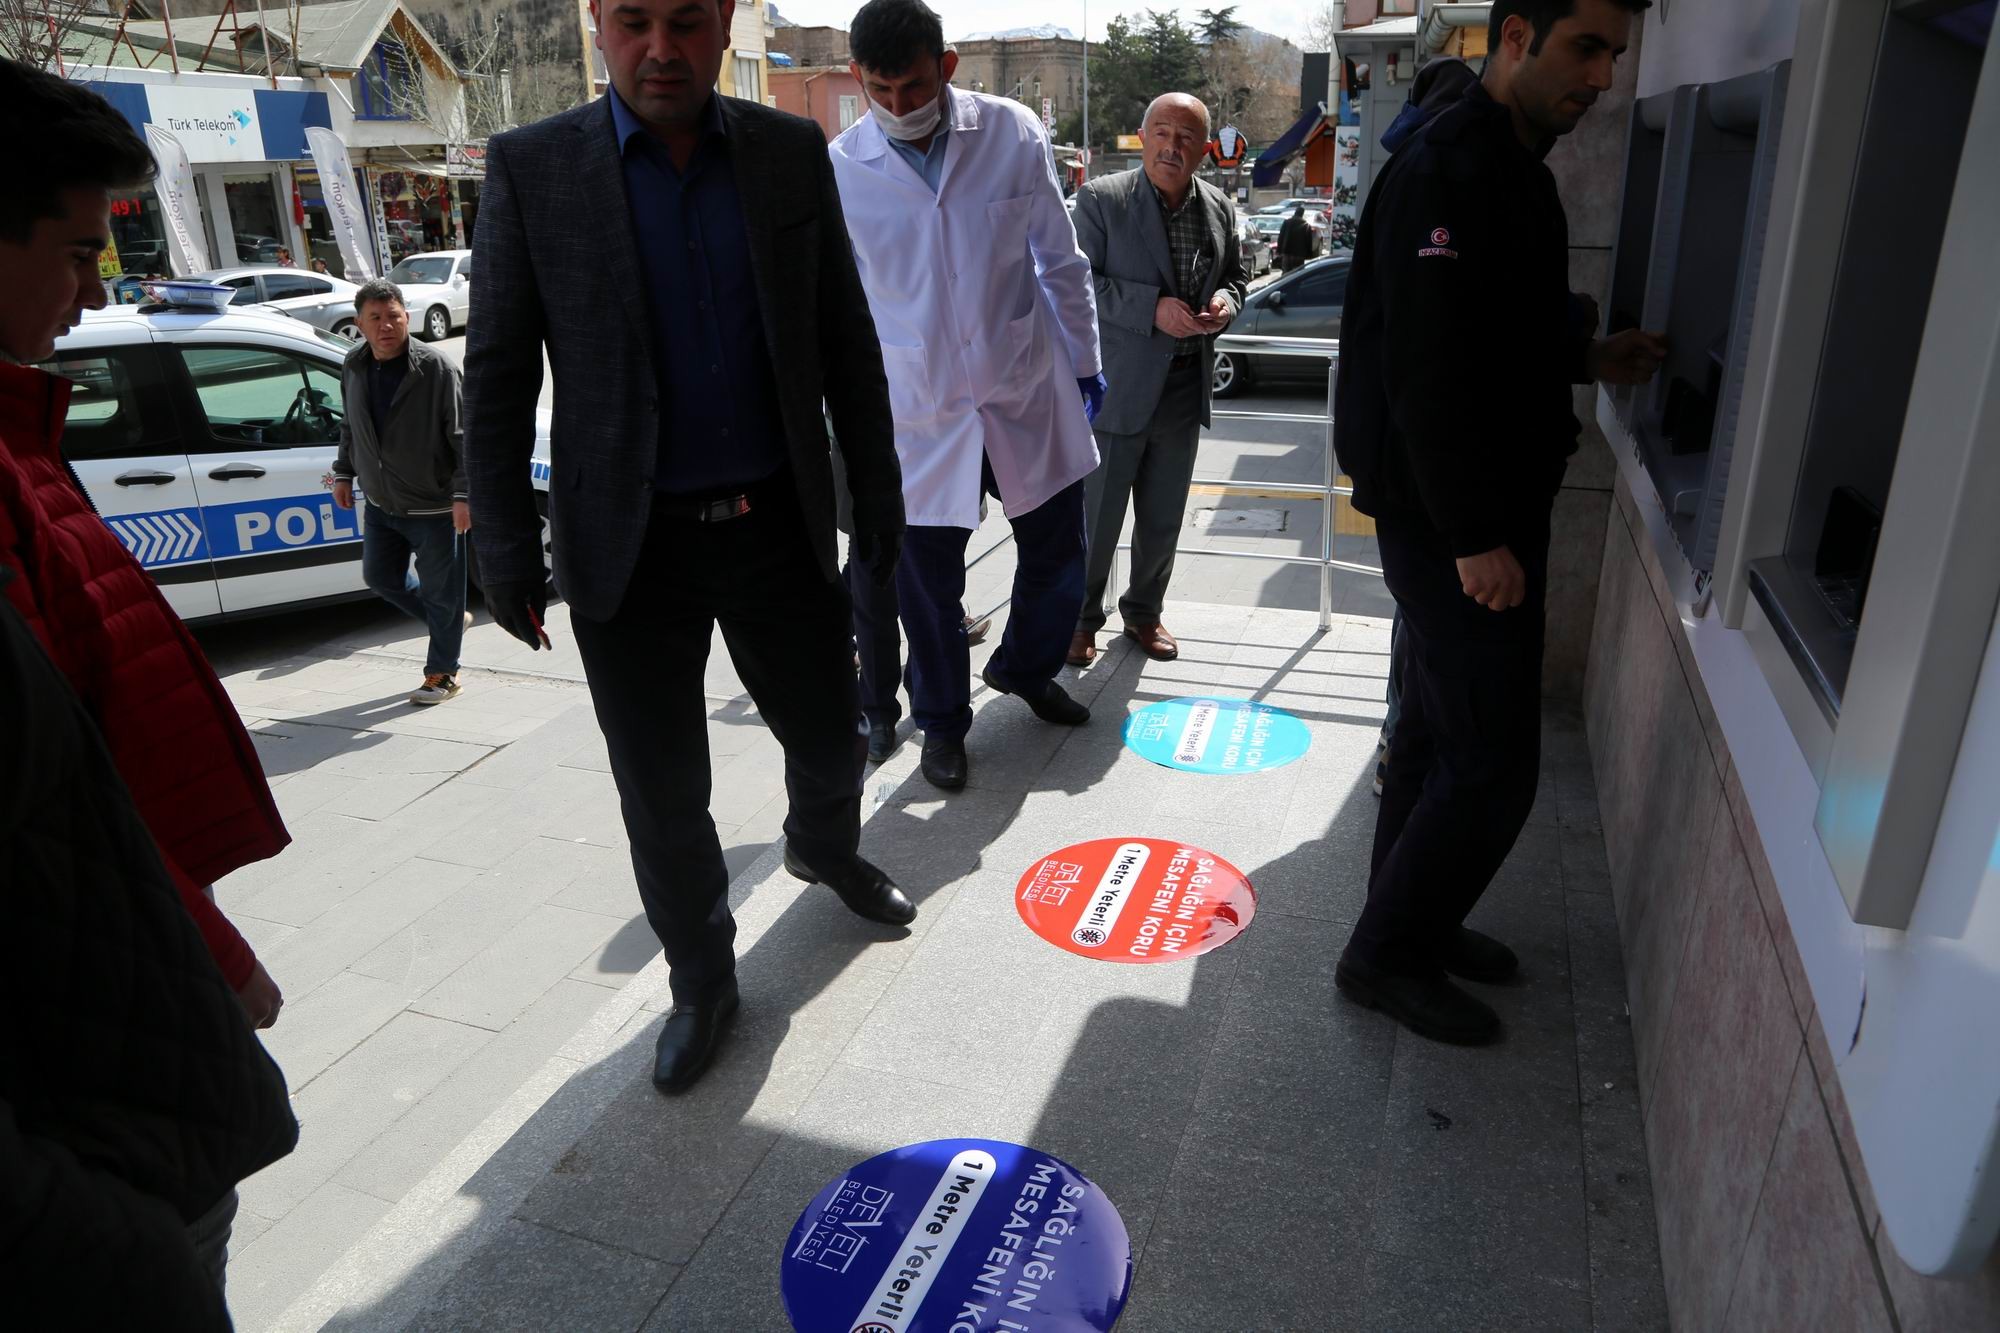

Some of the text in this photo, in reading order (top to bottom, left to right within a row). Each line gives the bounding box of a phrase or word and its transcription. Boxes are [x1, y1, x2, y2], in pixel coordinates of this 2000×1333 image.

[167, 118, 236, 131] Türk Telekom
[234, 491, 365, 552] POLİ
[1184, 730, 1203, 752] Yeterli
[1194, 709, 1210, 727] Metre
[1088, 889, 1120, 926] Yeterli
[1110, 855, 1137, 885] Metre
[1129, 848, 1193, 956] MESAFENİ KORU
[1160, 858, 1215, 953] SAĞLIĞIN İÇİN
[798, 1180, 861, 1263] BELEDİYESİ
[816, 1185, 889, 1272] DEVELİ
[876, 1162, 983, 1320] 1 Metre Yeterli
[972, 1163, 1057, 1297] MESAFENİ
[1007, 1183, 1085, 1312] SAĞLIĞIN
